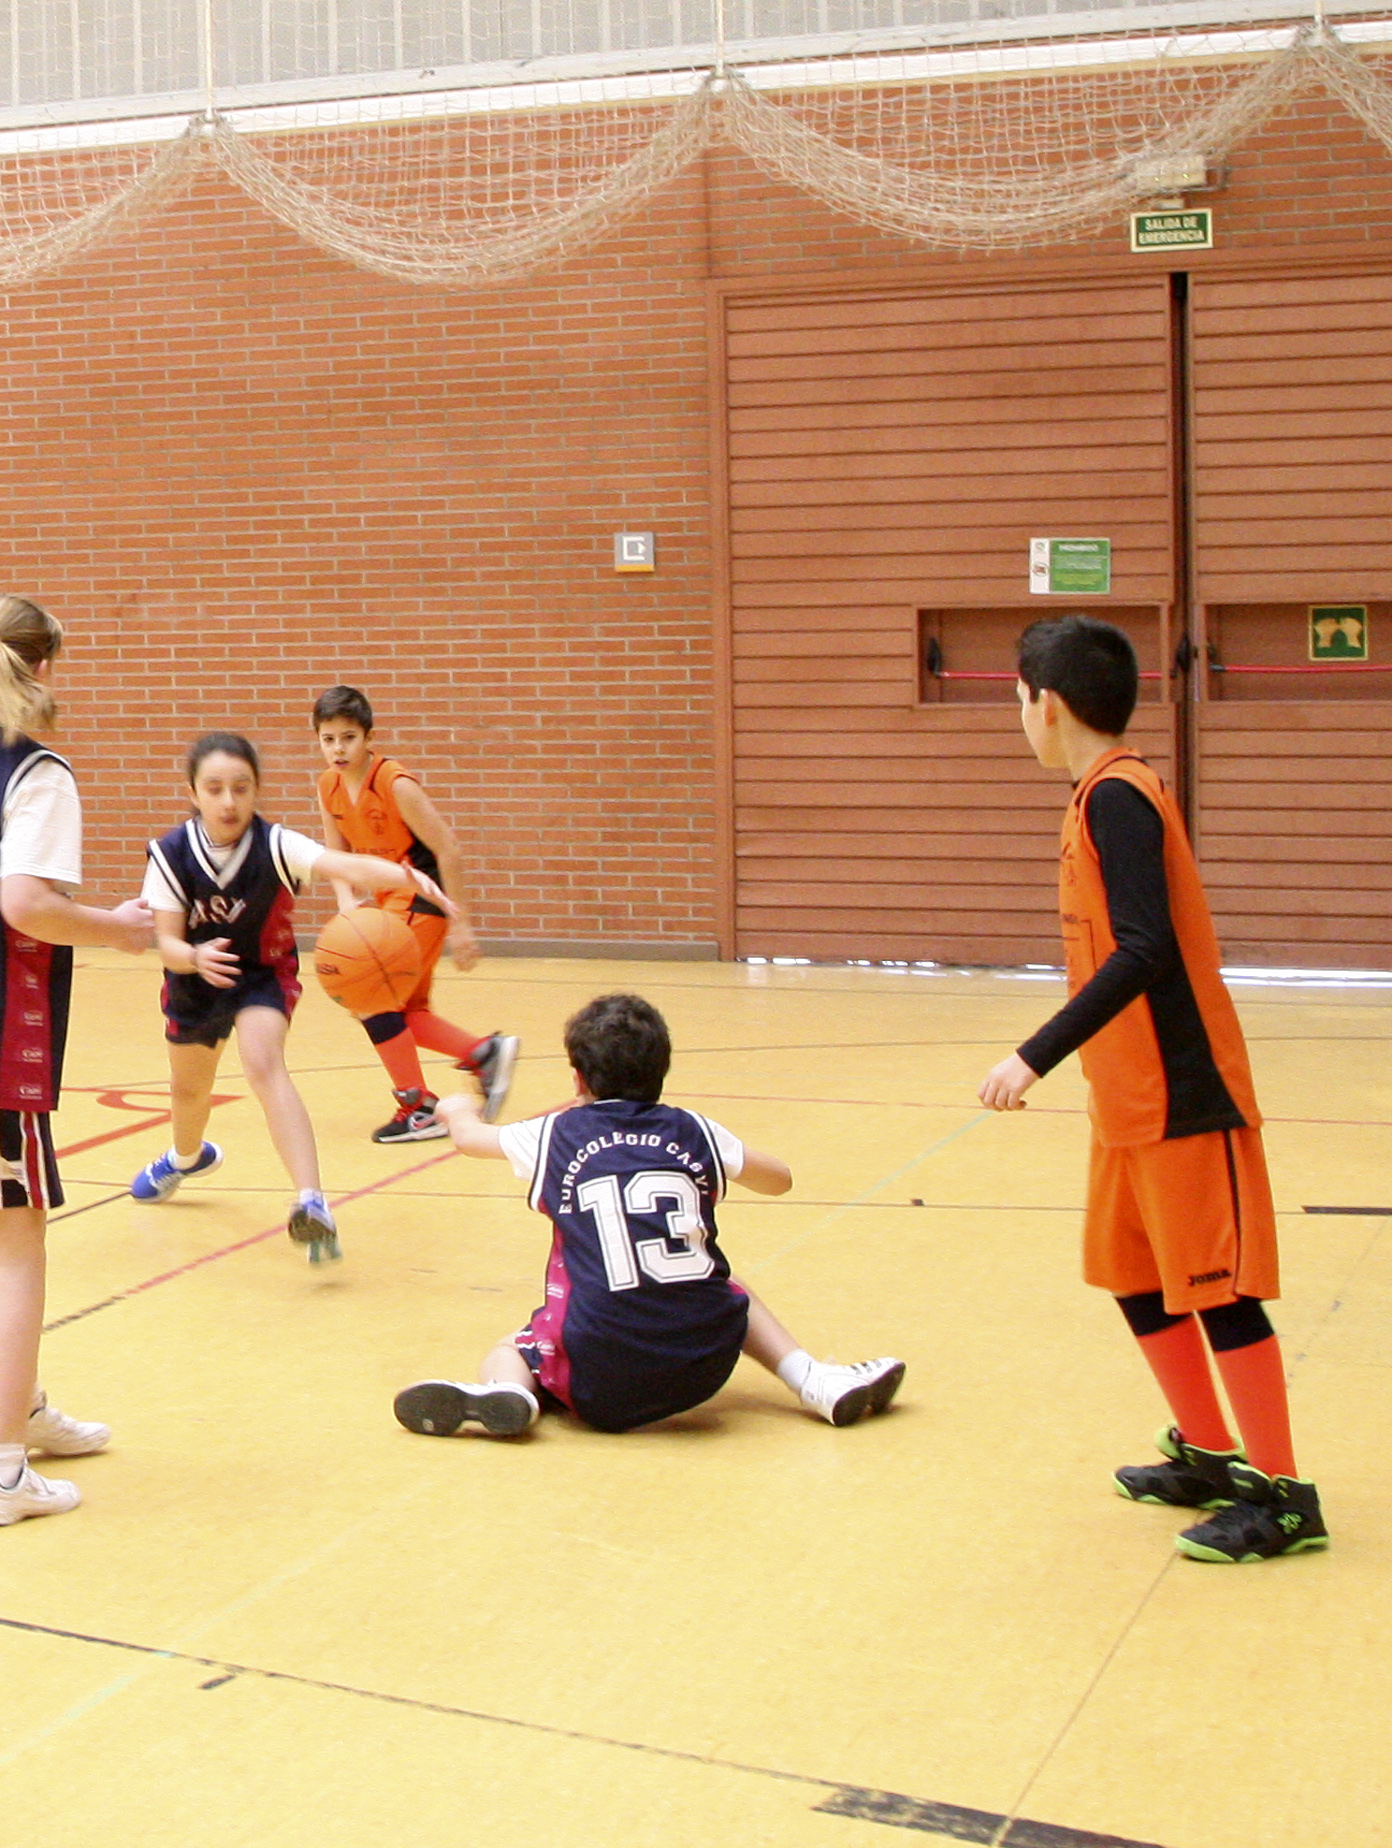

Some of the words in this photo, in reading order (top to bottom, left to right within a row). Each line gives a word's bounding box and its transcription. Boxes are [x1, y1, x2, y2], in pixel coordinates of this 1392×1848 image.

[1138, 229, 1206, 245] EMERGENCIA
[1144, 217, 1182, 231] SALIDA
[1182, 215, 1198, 229] DE
[188, 894, 247, 930] ASV
[558, 1131, 662, 1215] EUROCOLEGIO
[666, 1142, 709, 1196] CASVI
[576, 1170, 715, 1292] 13
